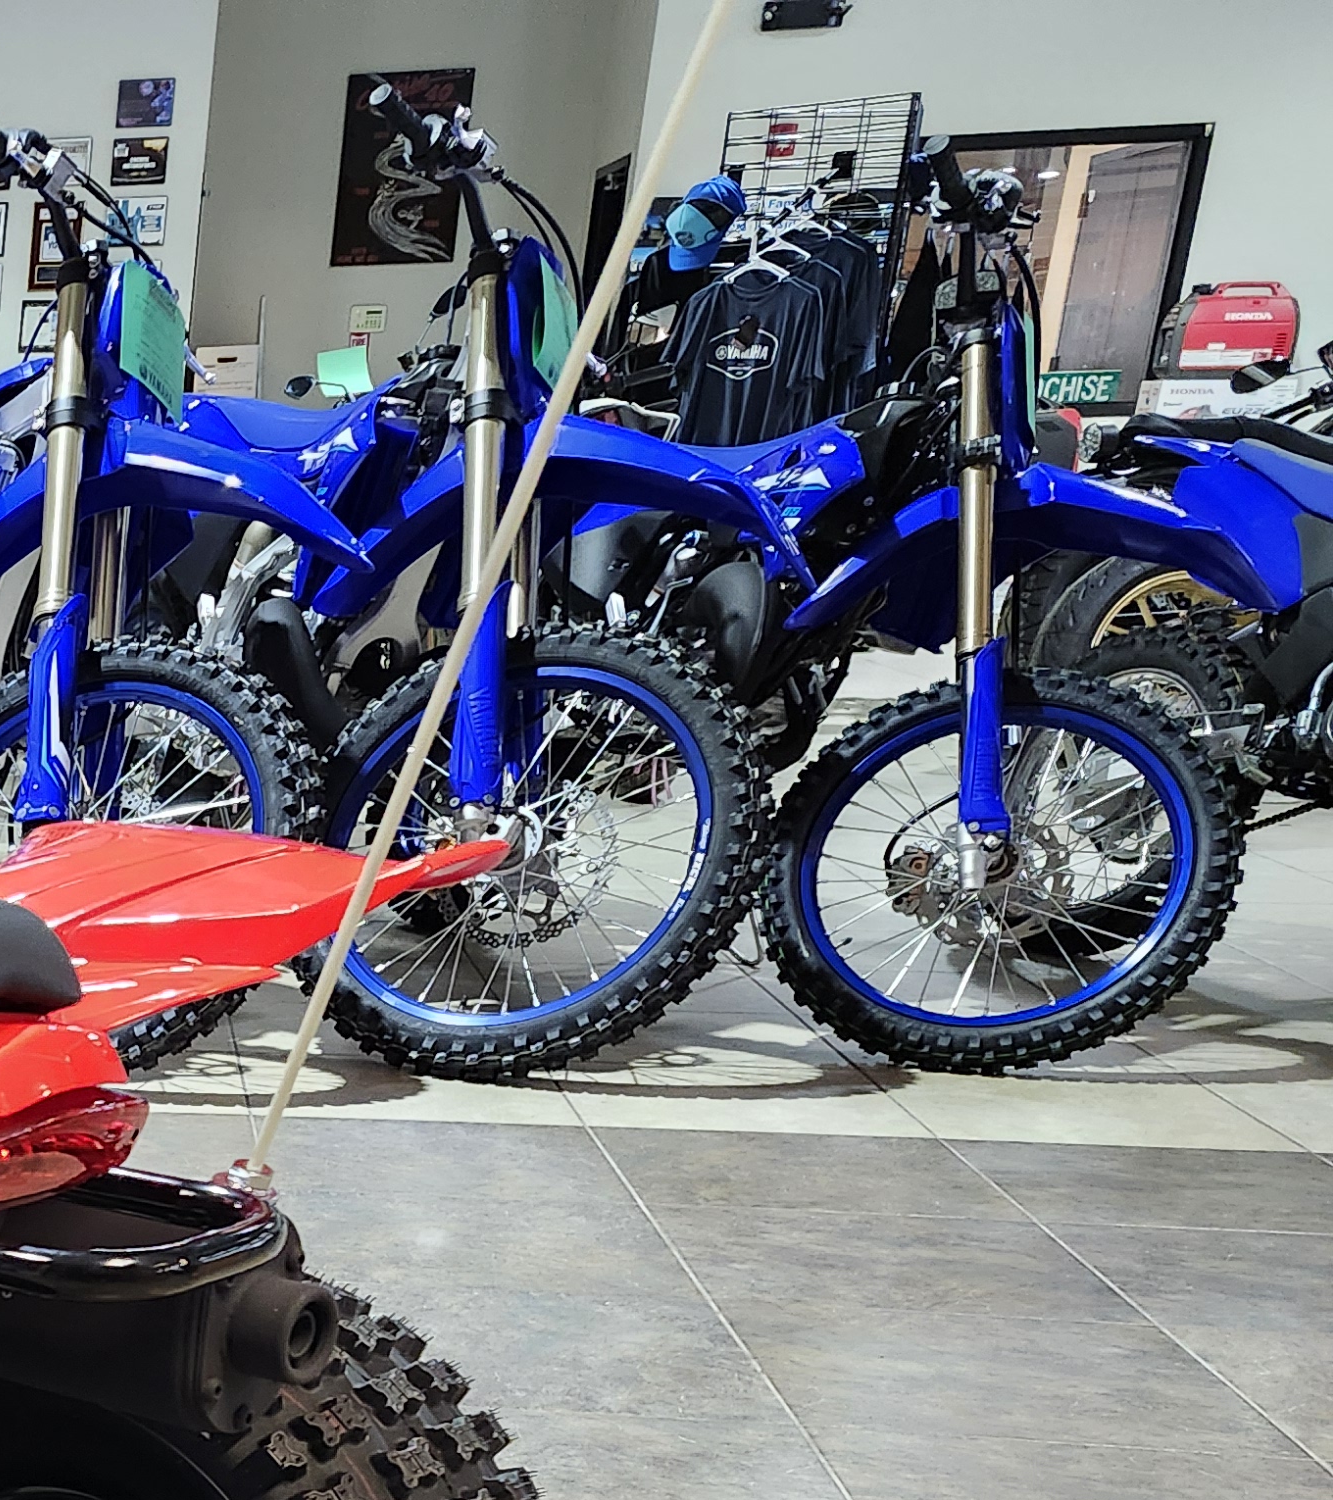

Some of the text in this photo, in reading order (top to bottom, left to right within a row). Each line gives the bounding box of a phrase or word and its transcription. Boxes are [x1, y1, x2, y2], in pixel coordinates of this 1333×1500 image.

[1224, 311, 1273, 321] HONDA
[727, 344, 769, 360] YAMAHA
[1038, 375, 1115, 402] CHISE
[1170, 388, 1215, 396] HONDA
